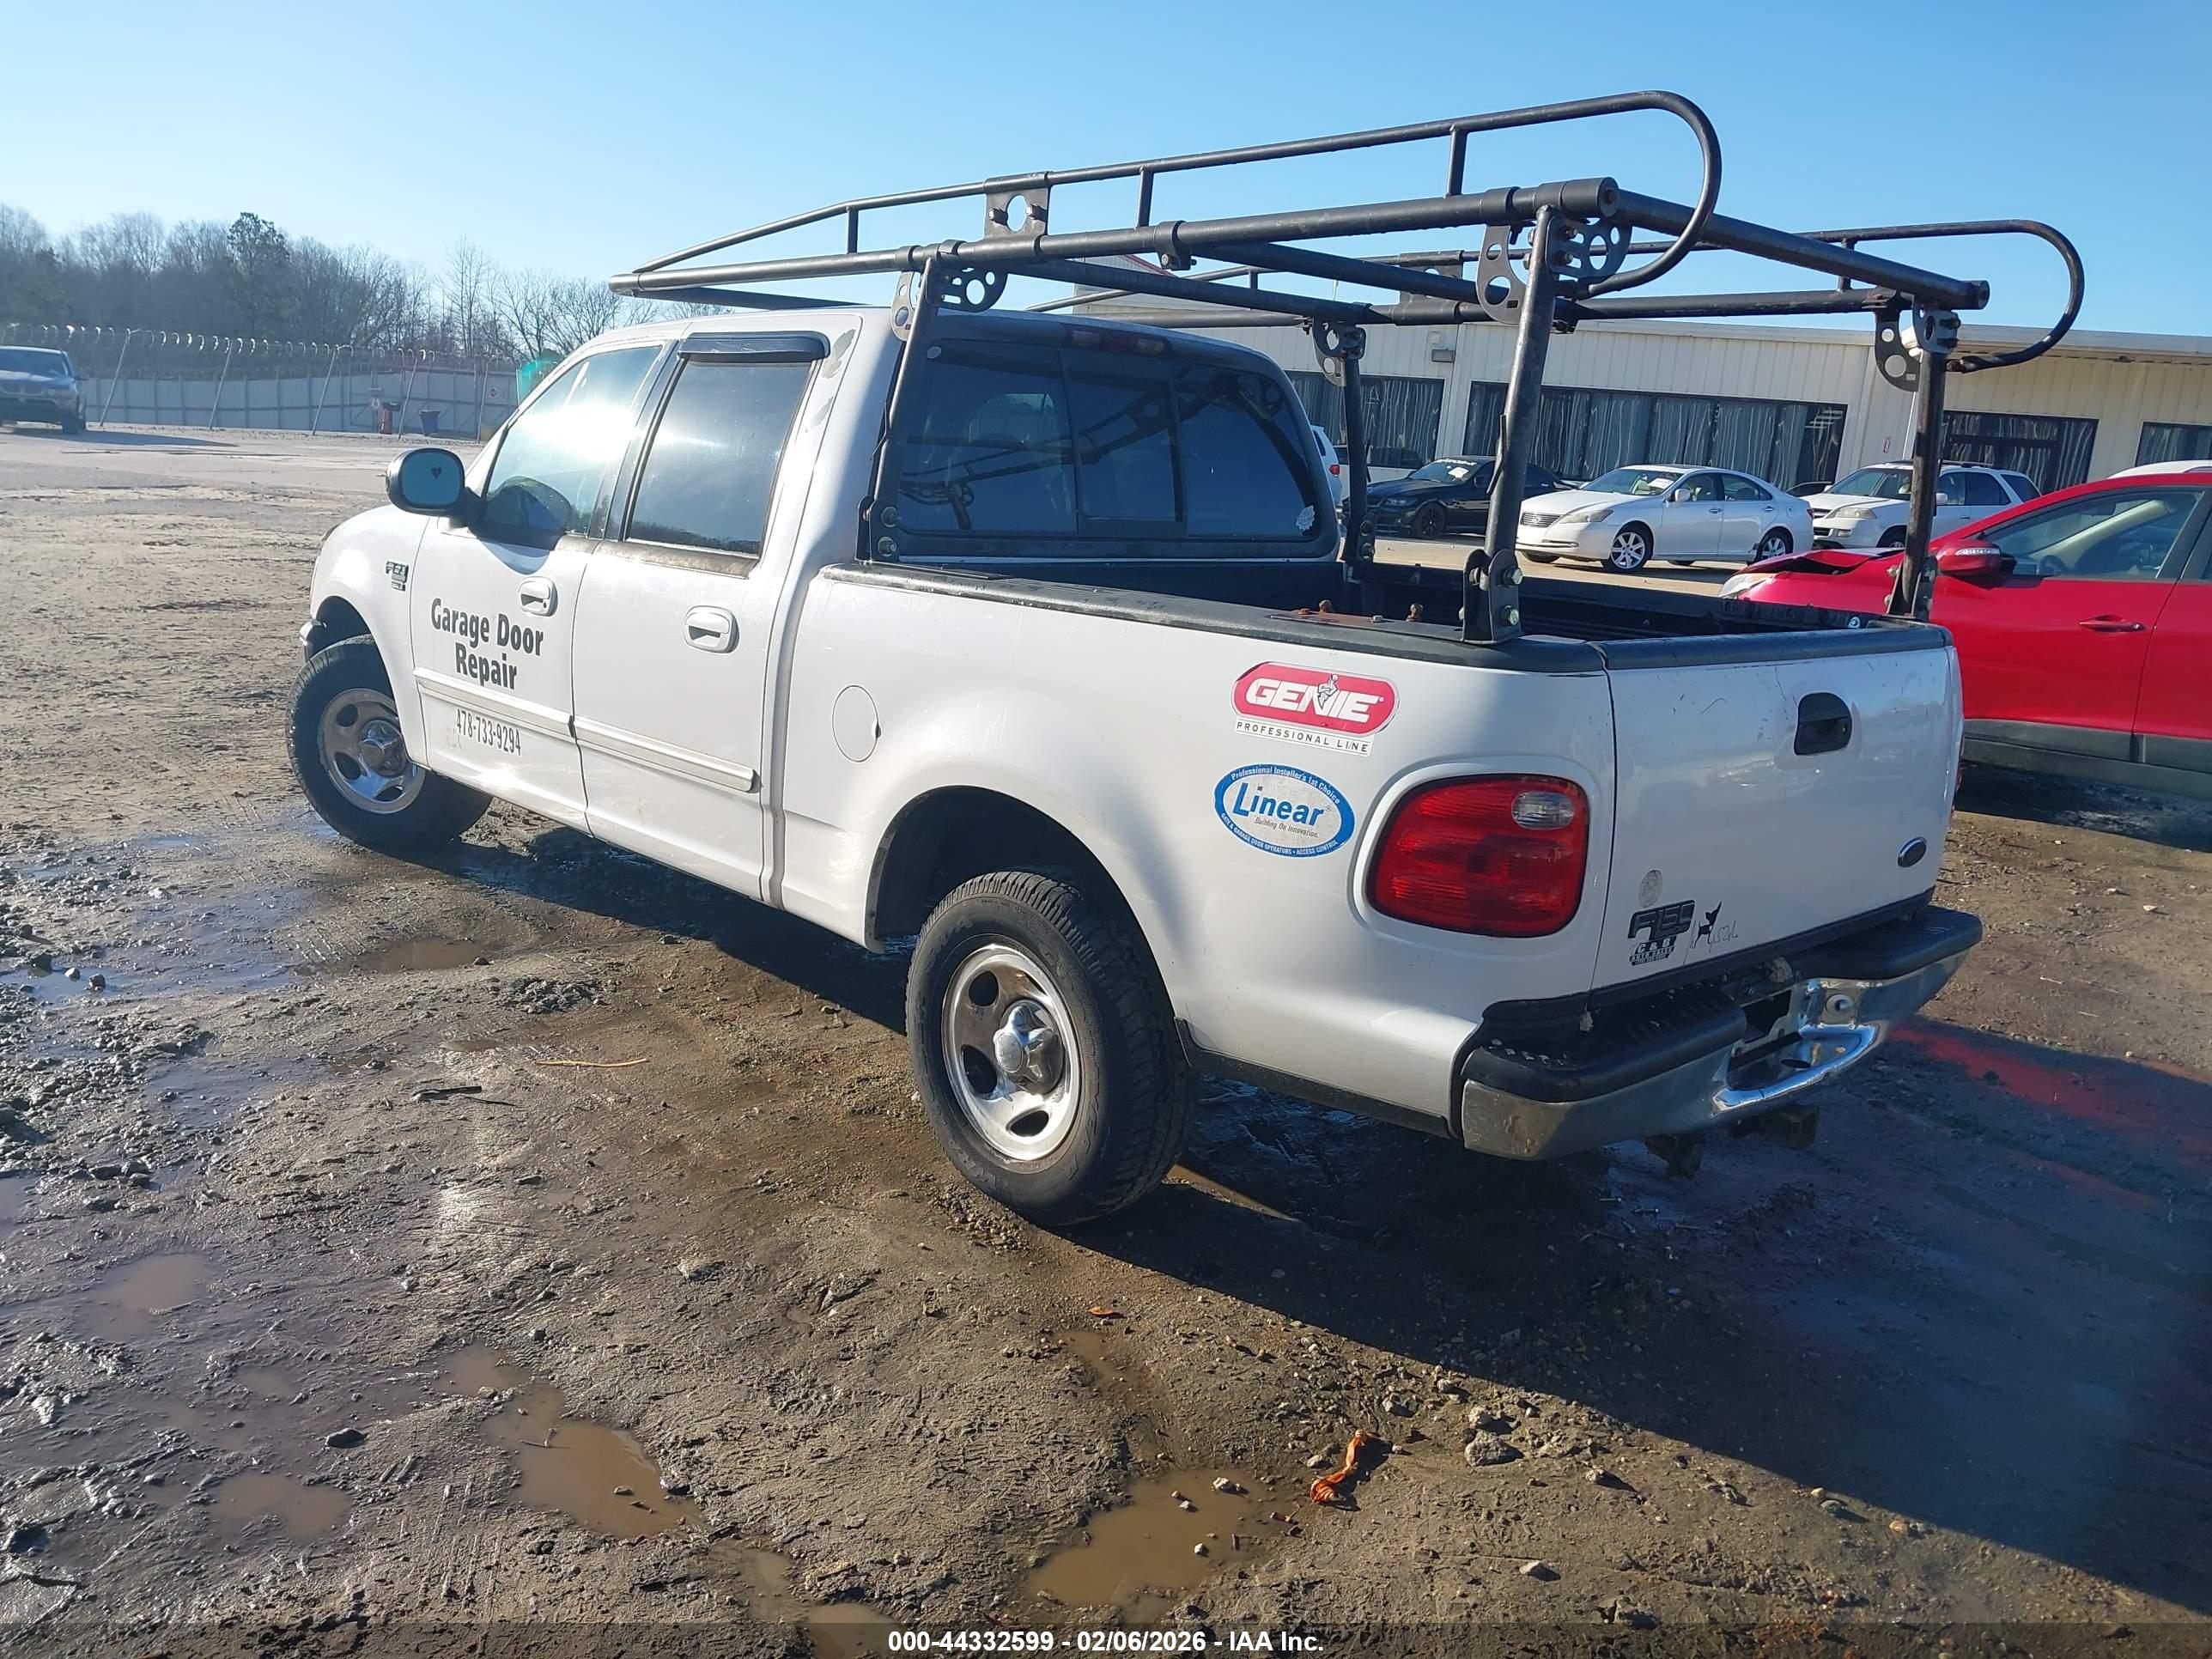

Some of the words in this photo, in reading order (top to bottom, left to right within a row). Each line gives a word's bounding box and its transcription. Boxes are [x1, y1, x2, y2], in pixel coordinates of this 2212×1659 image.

[431, 598, 490, 649] Garage
[496, 613, 544, 656] Door
[455, 642, 518, 690] Repair
[1245, 678, 1380, 723] GENIE
[457, 708, 522, 757] 478-733-9294
[1237, 721, 1329, 745] PROFESSIONAL
[1337, 739, 1368, 752] LINE
[1231, 766, 1273, 781] Professional
[1308, 775, 1319, 787] 1st
[1319, 779, 1340, 805] Choice
[1232, 782, 1324, 826] Linear
[1234, 826, 1251, 843] GARAGE
[1250, 836, 1264, 849] DOOR
[1264, 843, 1291, 855] OPERATORS
[1255, 817, 1278, 830] Building
[1279, 822, 1287, 831] On
[1296, 847, 1316, 855] ACCESS
[1316, 840, 1338, 854] CONTROL
[1638, 943, 1646, 953] C
[1649, 941, 1658, 951] &
[1662, 938, 1671, 948] B
